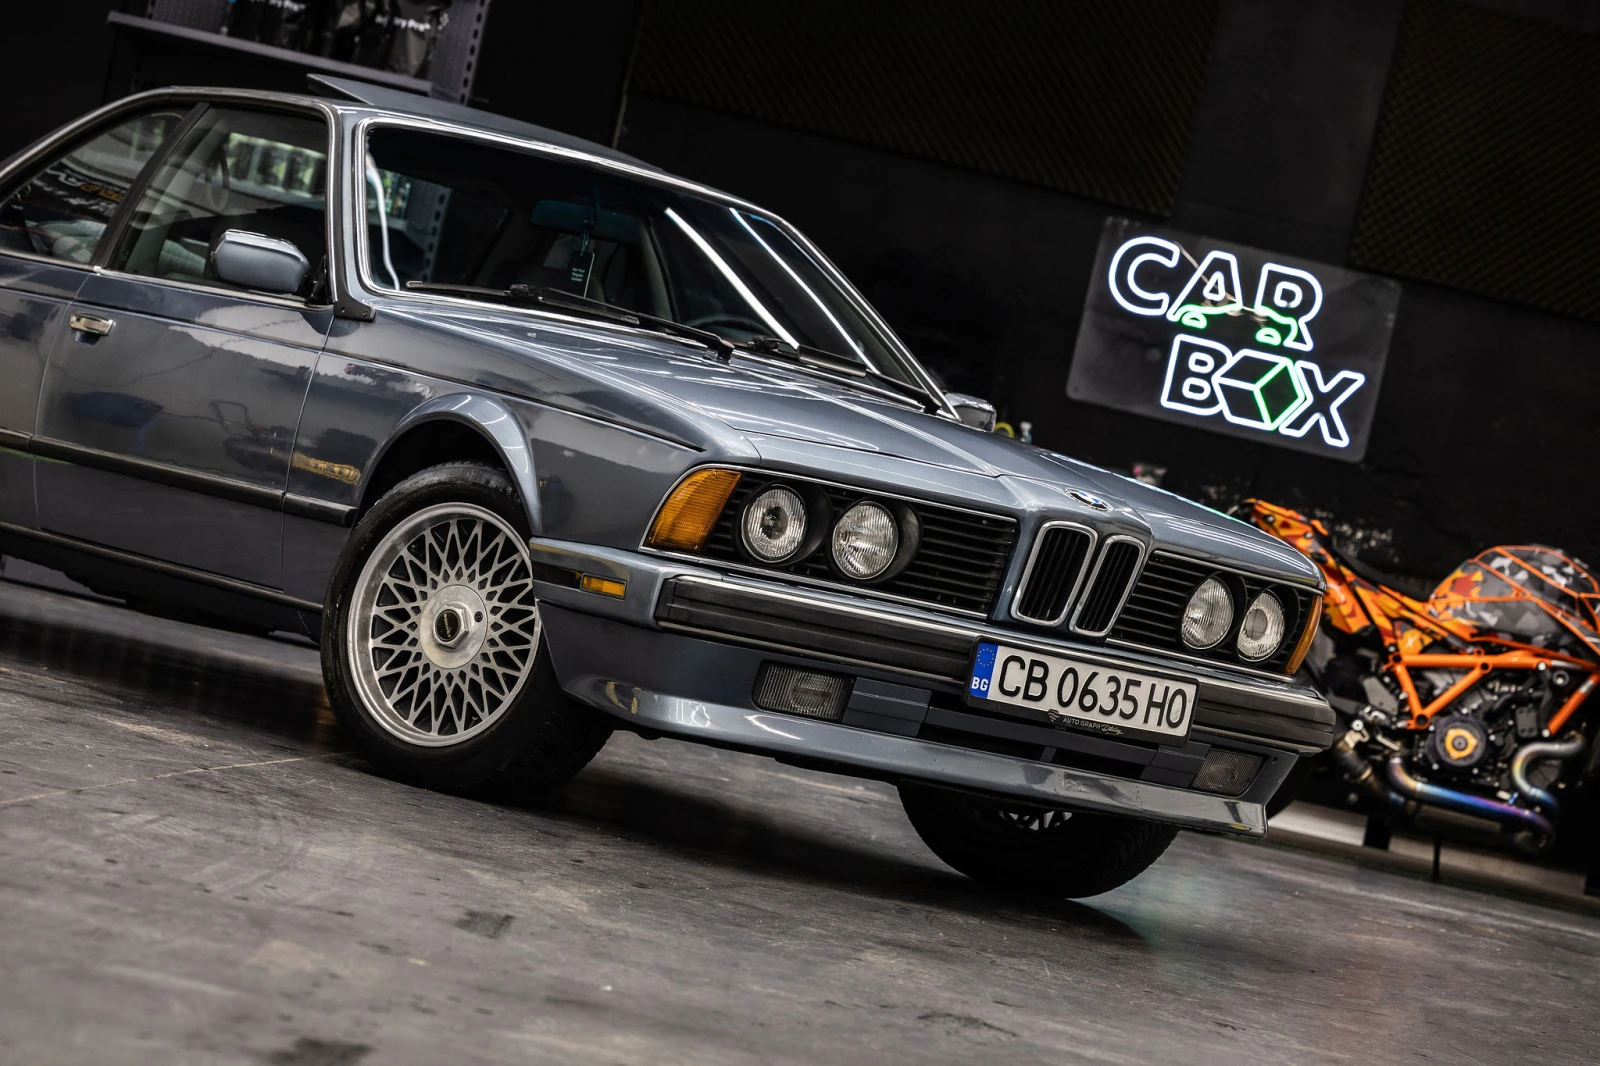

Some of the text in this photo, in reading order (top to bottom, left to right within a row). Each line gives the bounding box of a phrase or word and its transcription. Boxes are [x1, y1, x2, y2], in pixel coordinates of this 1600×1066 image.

[1108, 236, 1323, 352] CAR
[971, 676, 989, 692] BG
[998, 654, 1050, 702] CB
[1056, 666, 1142, 720] 0635
[1062, 717, 1080, 725] AUTO
[1080, 720, 1101, 730] GRAPH
